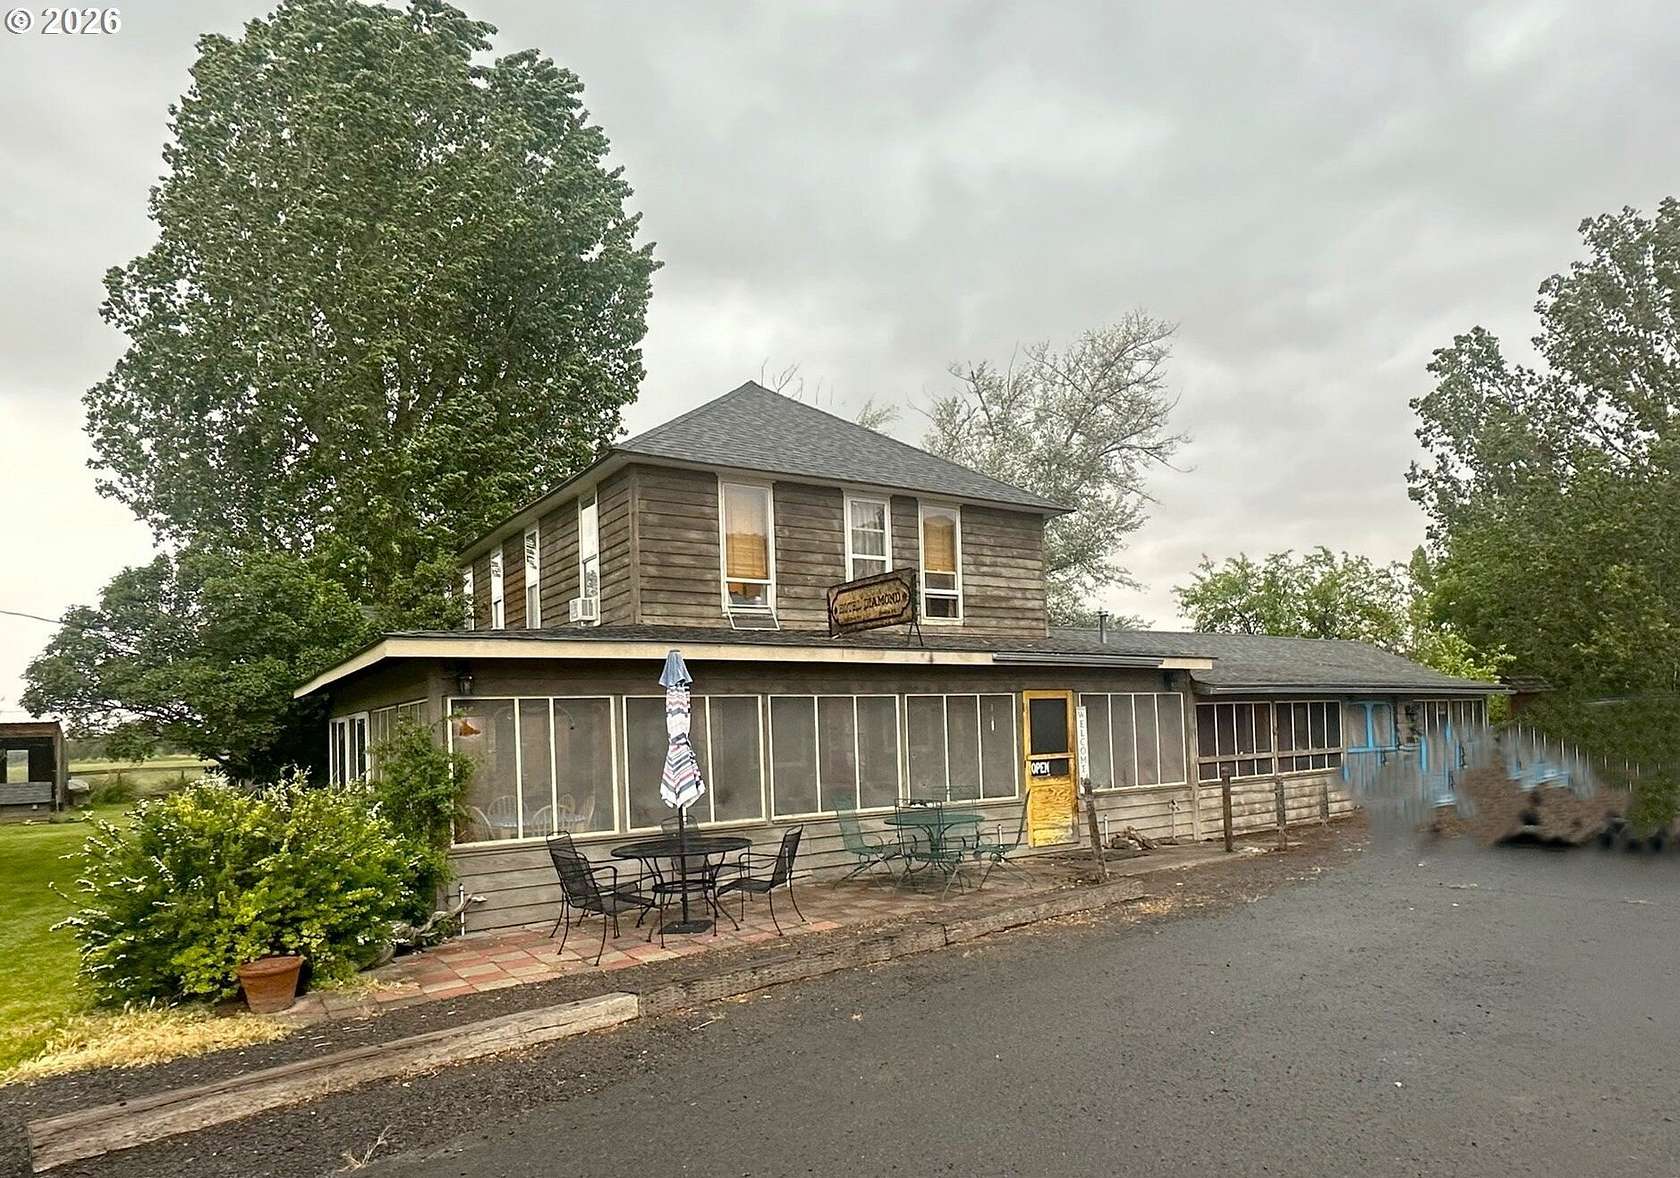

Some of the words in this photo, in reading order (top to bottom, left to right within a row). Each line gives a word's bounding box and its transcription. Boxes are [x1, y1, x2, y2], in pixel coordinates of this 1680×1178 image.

[863, 591, 901, 610] DIAMOND
[1078, 710, 1087, 773] WELCOME
[1031, 761, 1050, 774] OPEN
